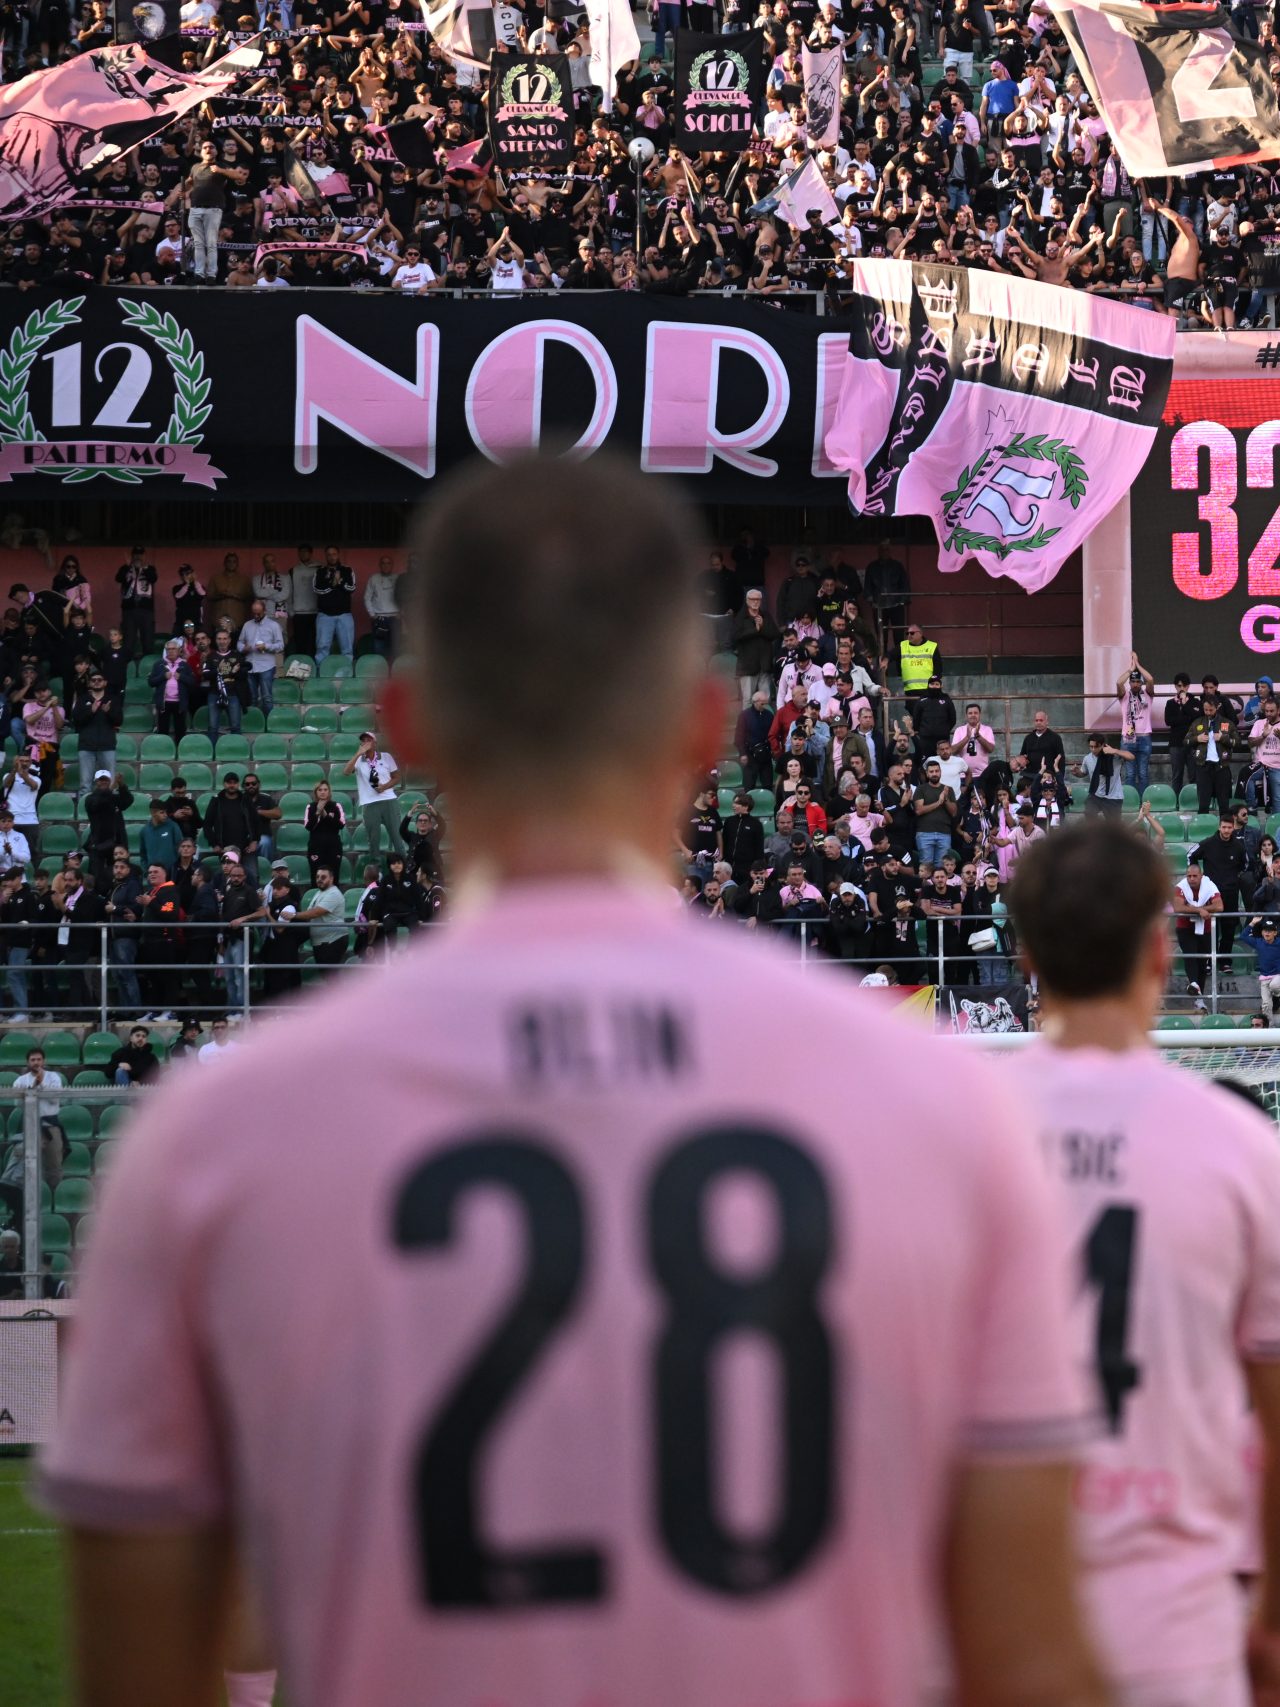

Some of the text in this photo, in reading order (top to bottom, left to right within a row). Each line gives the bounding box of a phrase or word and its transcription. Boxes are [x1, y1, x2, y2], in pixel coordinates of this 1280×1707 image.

[181, 28, 215, 36] ERMO
[705, 60, 735, 90] 12
[517, 74, 548, 104] 12
[212, 116, 262, 128] CURVA
[507, 124, 558, 137] SANTO
[685, 113, 751, 132] SCICLI
[364, 146, 398, 160] PAL
[499, 138, 568, 152] STEFANO
[749, 142, 773, 152] FORZ
[43, 341, 152, 428] 12
[295, 314, 852, 478] NOR
[24, 443, 177, 467] PALERMO
[386, 1118, 846, 1615] 28
